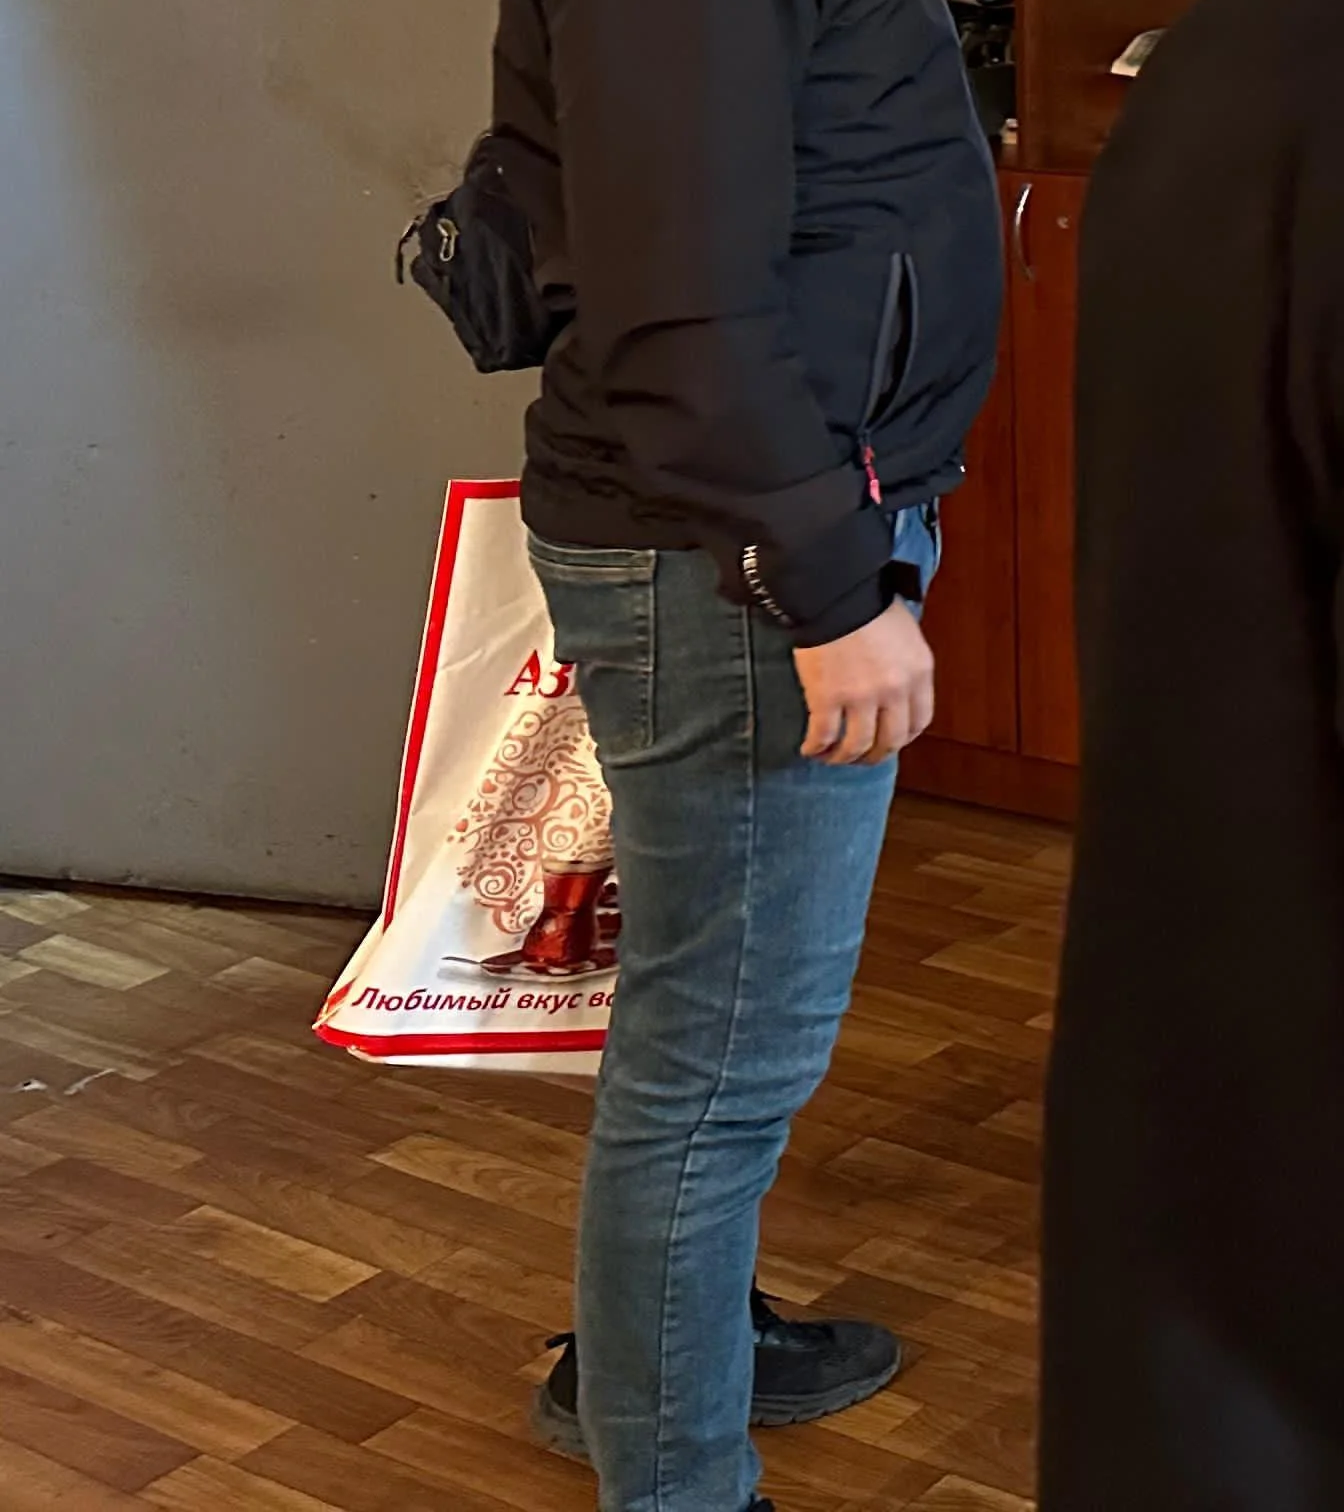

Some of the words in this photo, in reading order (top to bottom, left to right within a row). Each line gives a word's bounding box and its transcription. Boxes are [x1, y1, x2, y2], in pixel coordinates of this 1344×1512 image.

[503, 649, 578, 698] АЗ
[351, 987, 511, 1012] Любимый
[516, 991, 583, 1015] вкус
